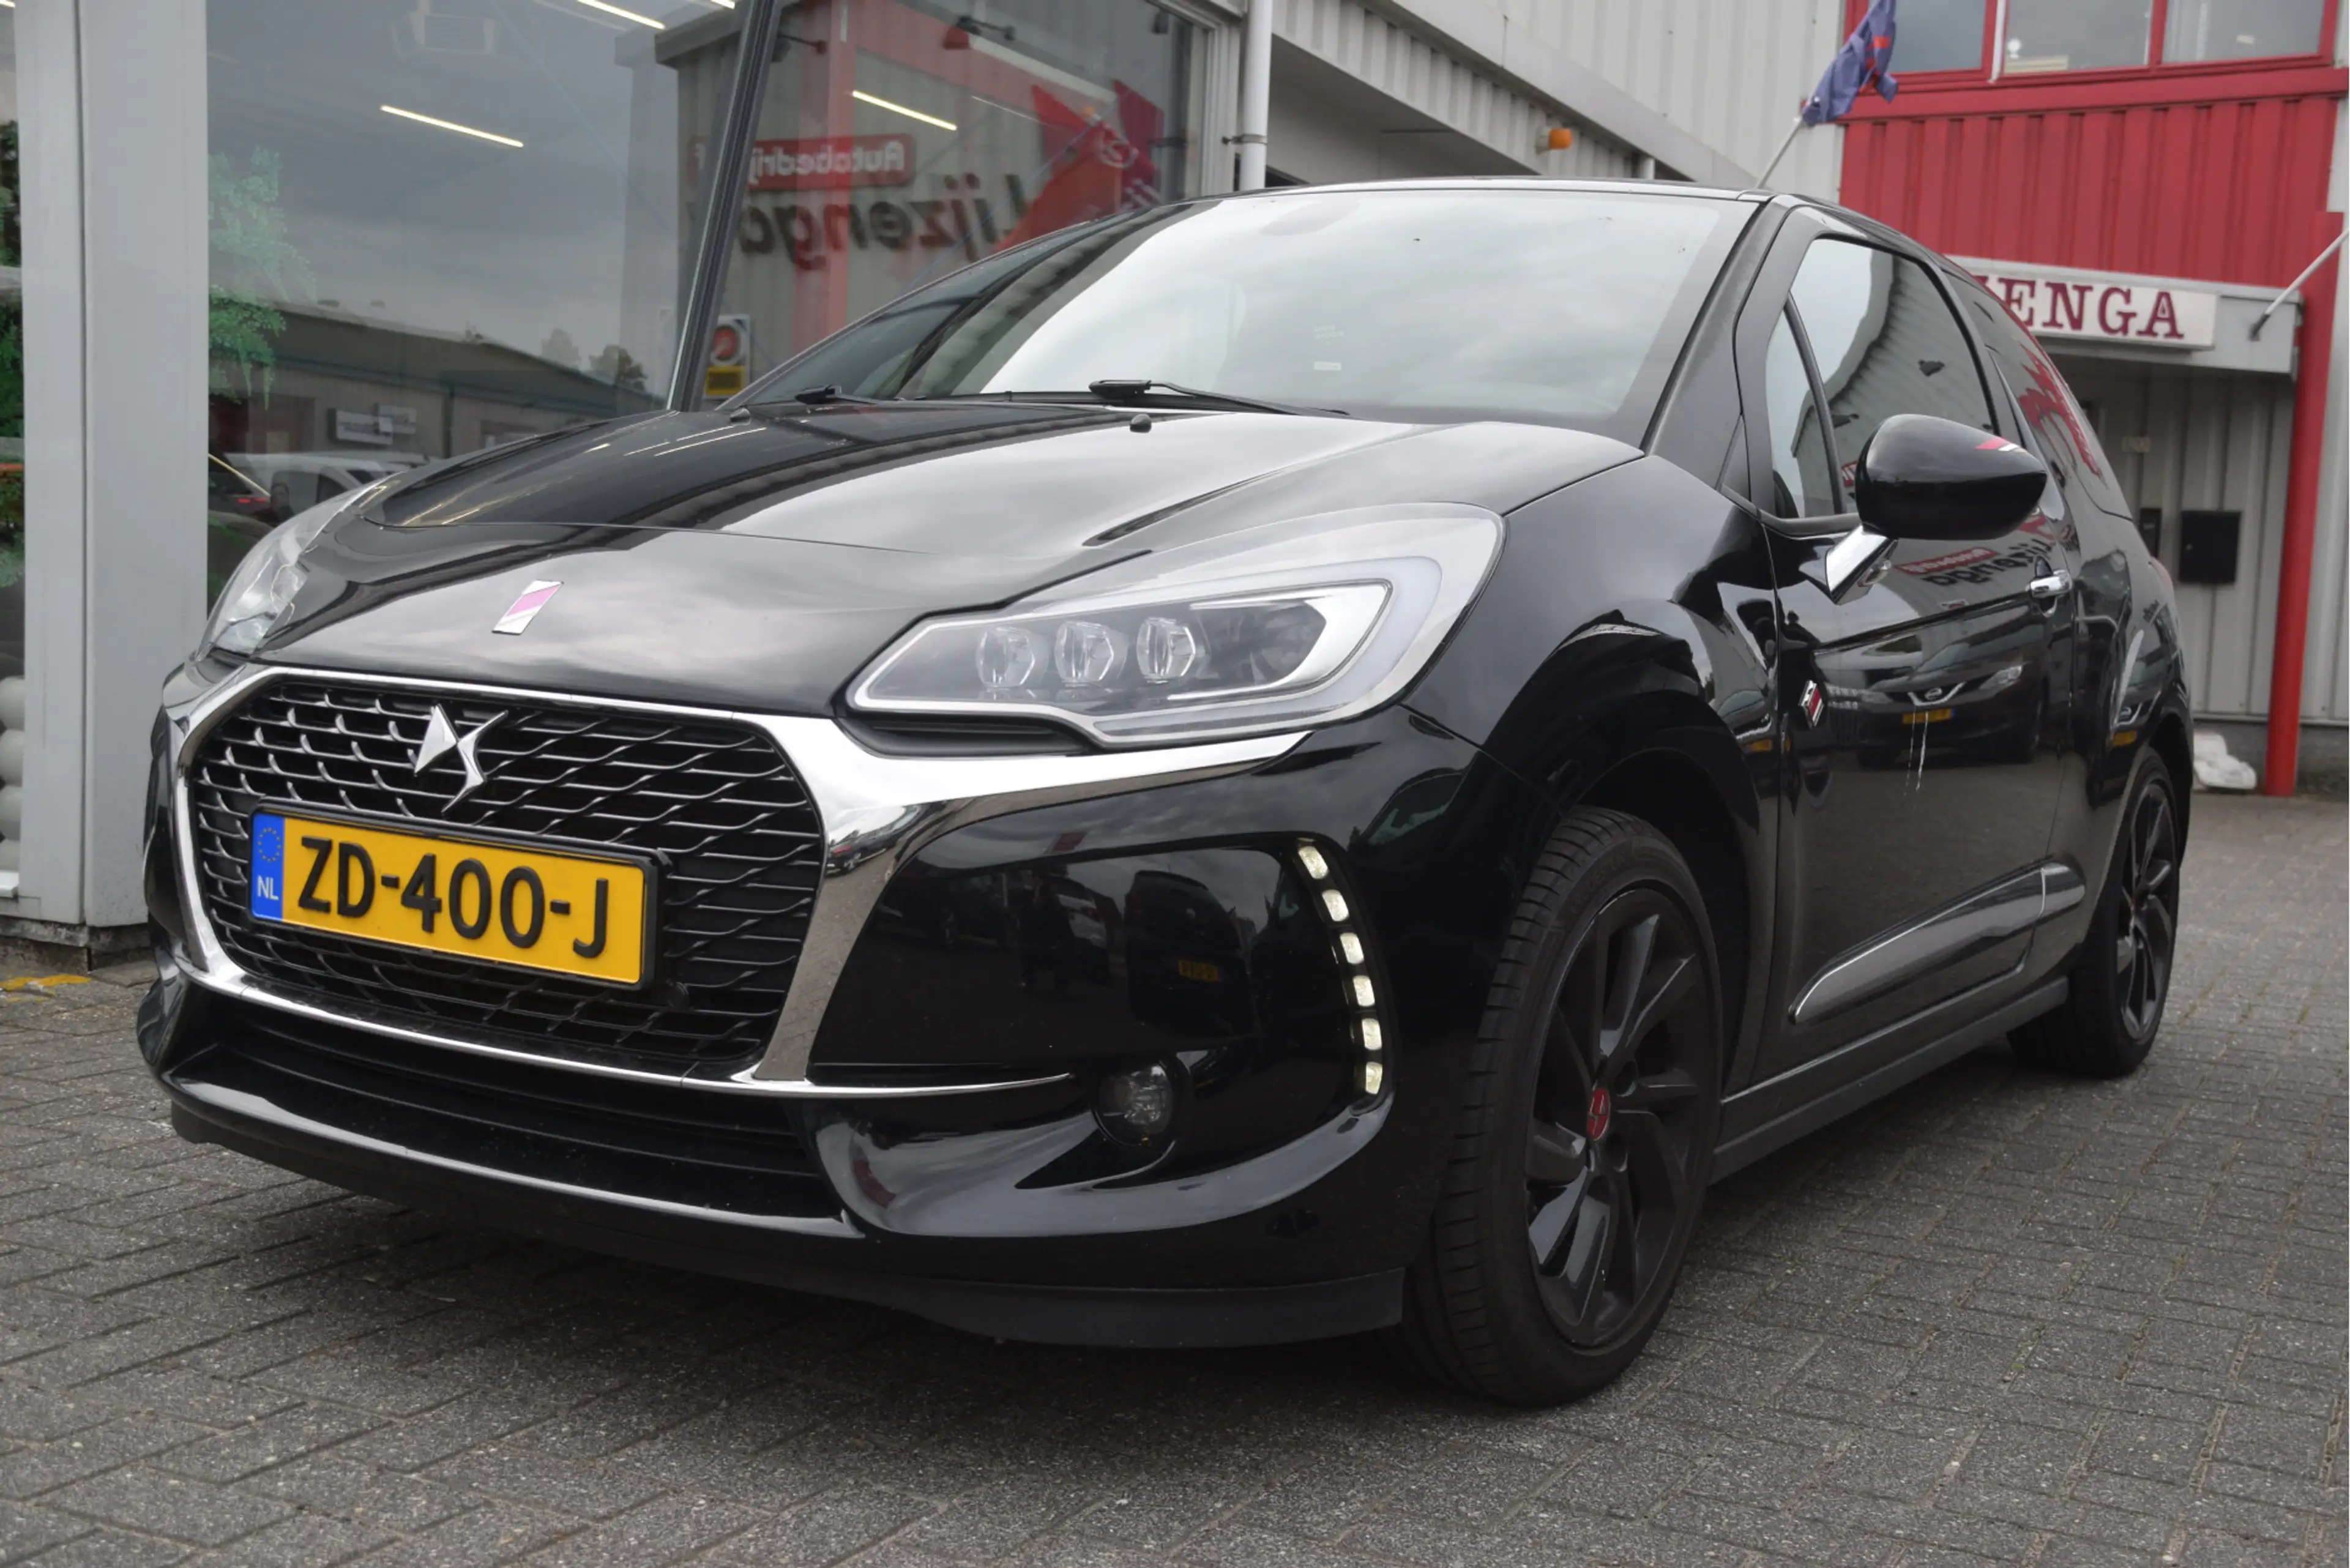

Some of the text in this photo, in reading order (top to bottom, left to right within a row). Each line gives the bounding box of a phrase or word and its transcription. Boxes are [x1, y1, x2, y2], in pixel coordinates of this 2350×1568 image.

[1974, 275, 2184, 340] ENGA
[257, 875, 279, 901] NL
[297, 835, 609, 959] ZD-400-J
